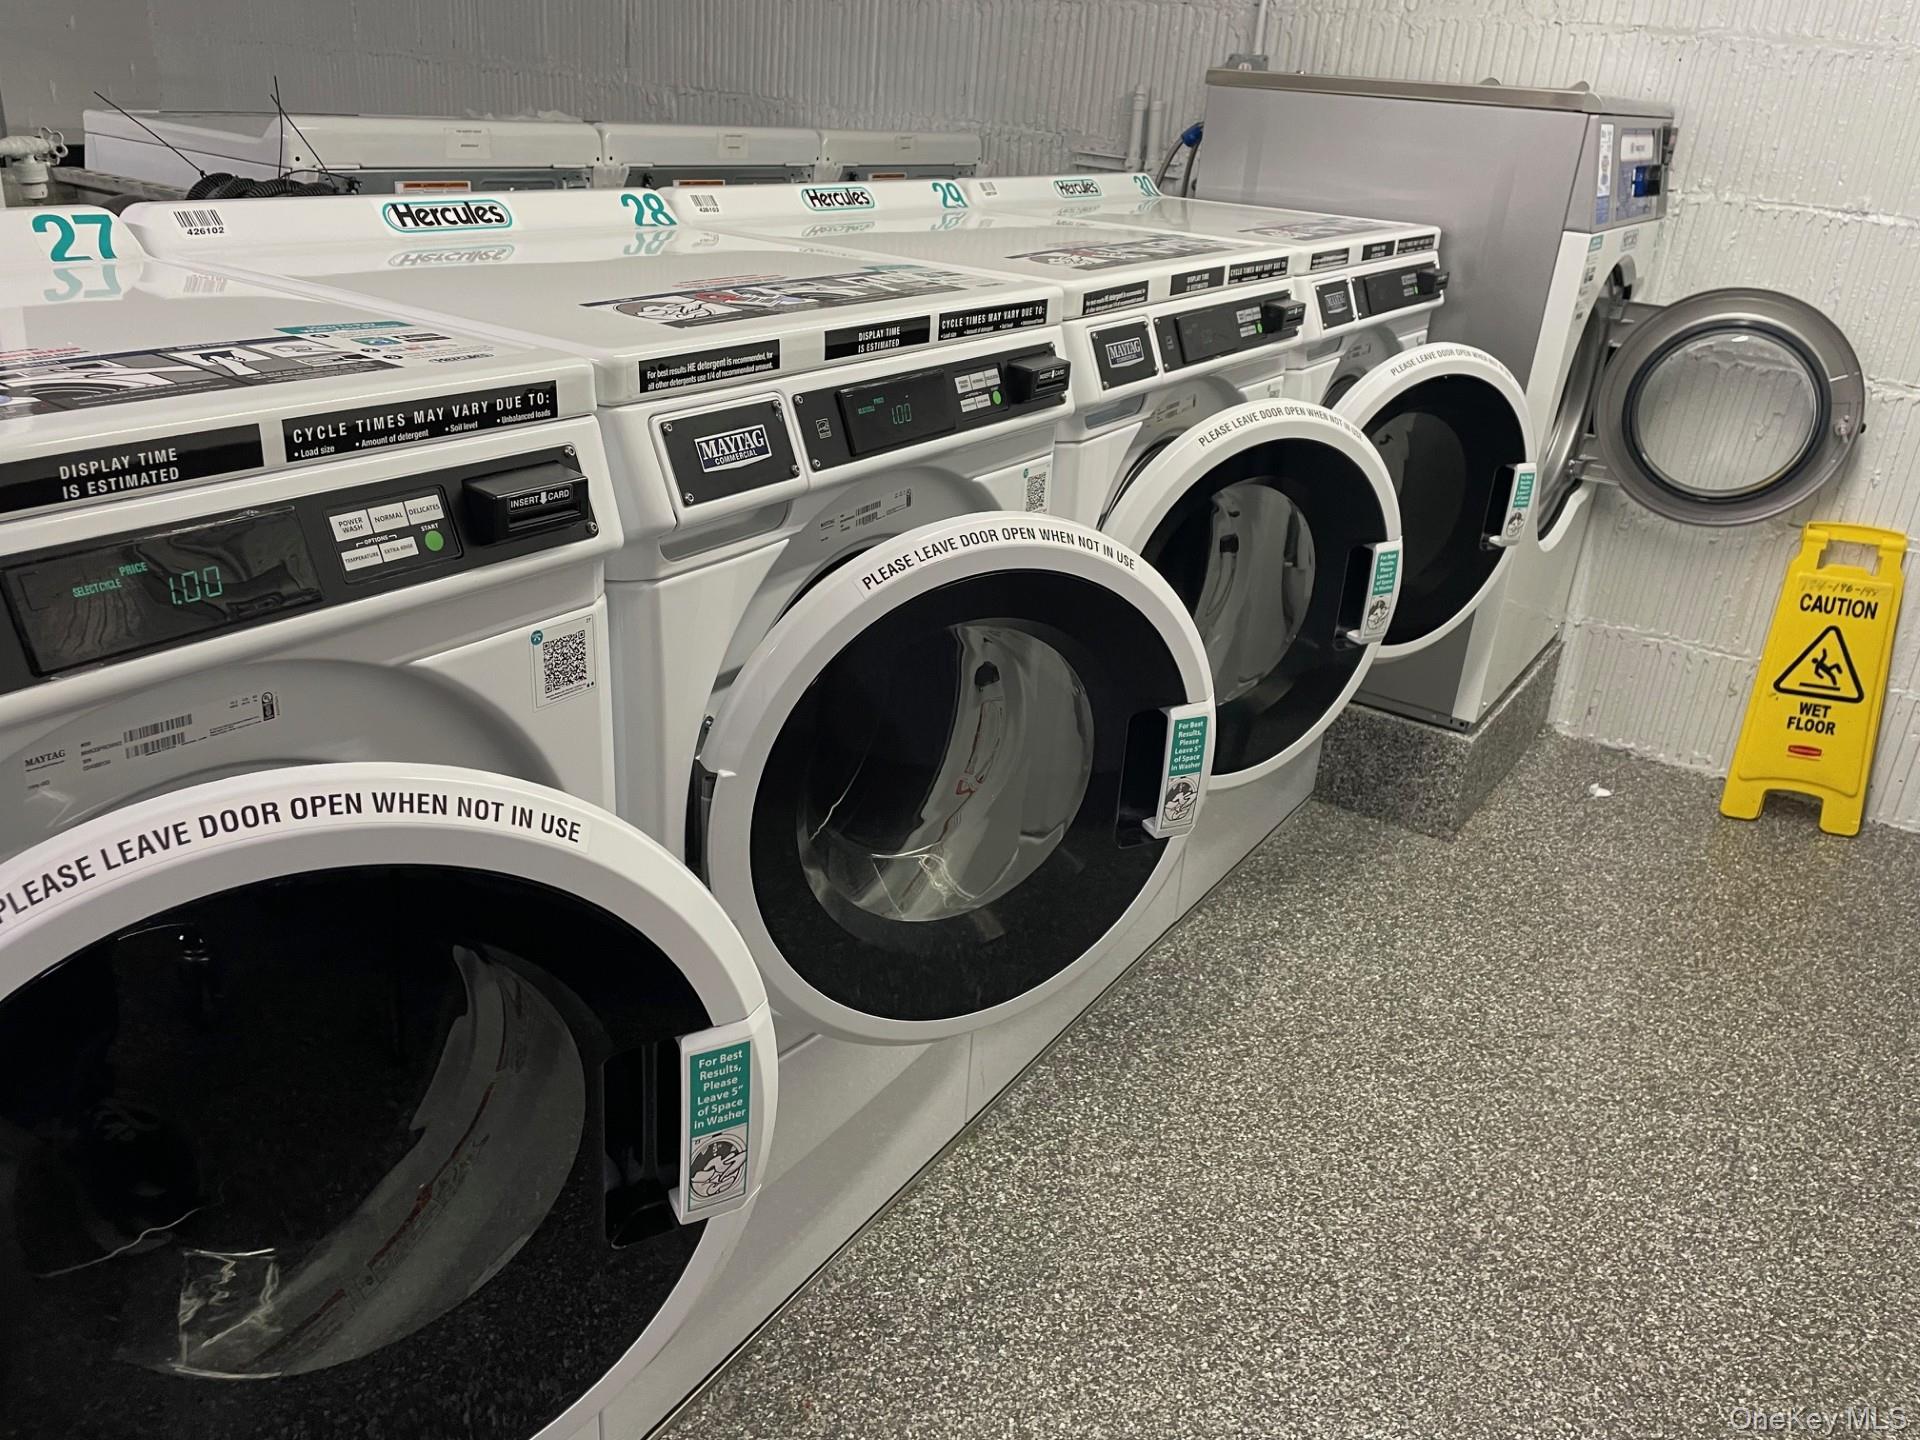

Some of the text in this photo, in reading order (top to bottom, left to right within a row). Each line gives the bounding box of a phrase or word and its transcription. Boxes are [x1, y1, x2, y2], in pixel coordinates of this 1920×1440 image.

[932, 182, 968, 208] 29
[1055, 179, 1098, 195] Hercules
[1134, 175, 1162, 197] 30
[805, 187, 870, 208] Hercules
[389, 200, 506, 228] Hercules
[621, 193, 678, 227] 28
[32, 214, 117, 262] 27
[187, 227, 225, 236] 426102
[942, 318, 963, 330] CYCLE
[966, 314, 986, 326] TIMES
[987, 311, 1002, 322] MAY
[1004, 309, 1019, 320] VARY
[1021, 307, 1033, 317] DUE
[858, 326, 901, 342] DISPLAY TIME
[858, 339, 900, 354] IS ESTIMATED
[1109, 341, 1141, 359] MAYTAG
[647, 370, 657, 379] For
[657, 369, 669, 378] best
[669, 366, 687, 376] results
[687, 363, 696, 372] HE
[697, 357, 727, 371] detergent
[727, 356, 732, 365] is
[1390, 360, 1417, 376] PLEASE
[655, 380, 669, 389] other
[698, 374, 706, 382] use
[707, 371, 716, 380] 1/4
[716, 370, 721, 378] of
[293, 392, 550, 443] CYCLE TIMES MAY VARY DUE TO:
[501, 408, 551, 424] Unbalanced loads
[450, 420, 478, 433] Soil level
[1198, 424, 1233, 447] PLEASE
[1231, 411, 1259, 429] LEAVE
[1260, 407, 1284, 420] DOOR
[1285, 406, 1306, 416] OPEN
[1307, 408, 1329, 421] WHEN
[361, 428, 429, 448] Amount of detergent
[700, 430, 765, 460] MAYTAG
[300, 444, 335, 458] Load size
[714, 448, 758, 465] COMMERCIAL
[59, 448, 178, 480] DISPLAY TIME
[62, 467, 180, 499] IS ESTIMATED
[510, 489, 570, 508] INSERT CARD
[374, 511, 403, 523] NORMAL
[408, 503, 441, 516] DELICATES
[338, 516, 363, 527] POWER
[342, 524, 364, 534] WASH
[420, 522, 439, 532] START
[364, 534, 388, 545] OPTIONS
[862, 527, 1136, 590] PLEASE LEAVE DOOR OPEN WHEN NOT IN USE
[119, 561, 148, 577] PRICE
[72, 578, 122, 598] SELECT CYCLE
[169, 565, 223, 605] 1.00
[1800, 593, 1878, 620] CAUTION
[1799, 702, 1831, 719] WET
[1178, 721, 1203, 730] For Best
[1787, 716, 1836, 735] FLOOR
[25, 750, 65, 767] MAYTAG
[1174, 747, 1193, 755] Leave
[1174, 755, 1200, 763] of Space
[1179, 762, 1201, 770] Washer
[100, 822, 191, 871] LEAVE
[199, 802, 281, 838] DOOR
[290, 793, 363, 820] OPEN
[371, 792, 447, 815] WHEN
[457, 797, 504, 822] NOT
[511, 805, 533, 828] IN
[541, 812, 581, 843] USE
[698, 1050, 743, 1069] For Best
[700, 1065, 742, 1081] Results,
[703, 1077, 738, 1092] Please
[697, 1091, 729, 1105] Leave
[697, 1098, 743, 1117] of Space
[694, 1109, 746, 1130] in Washer
